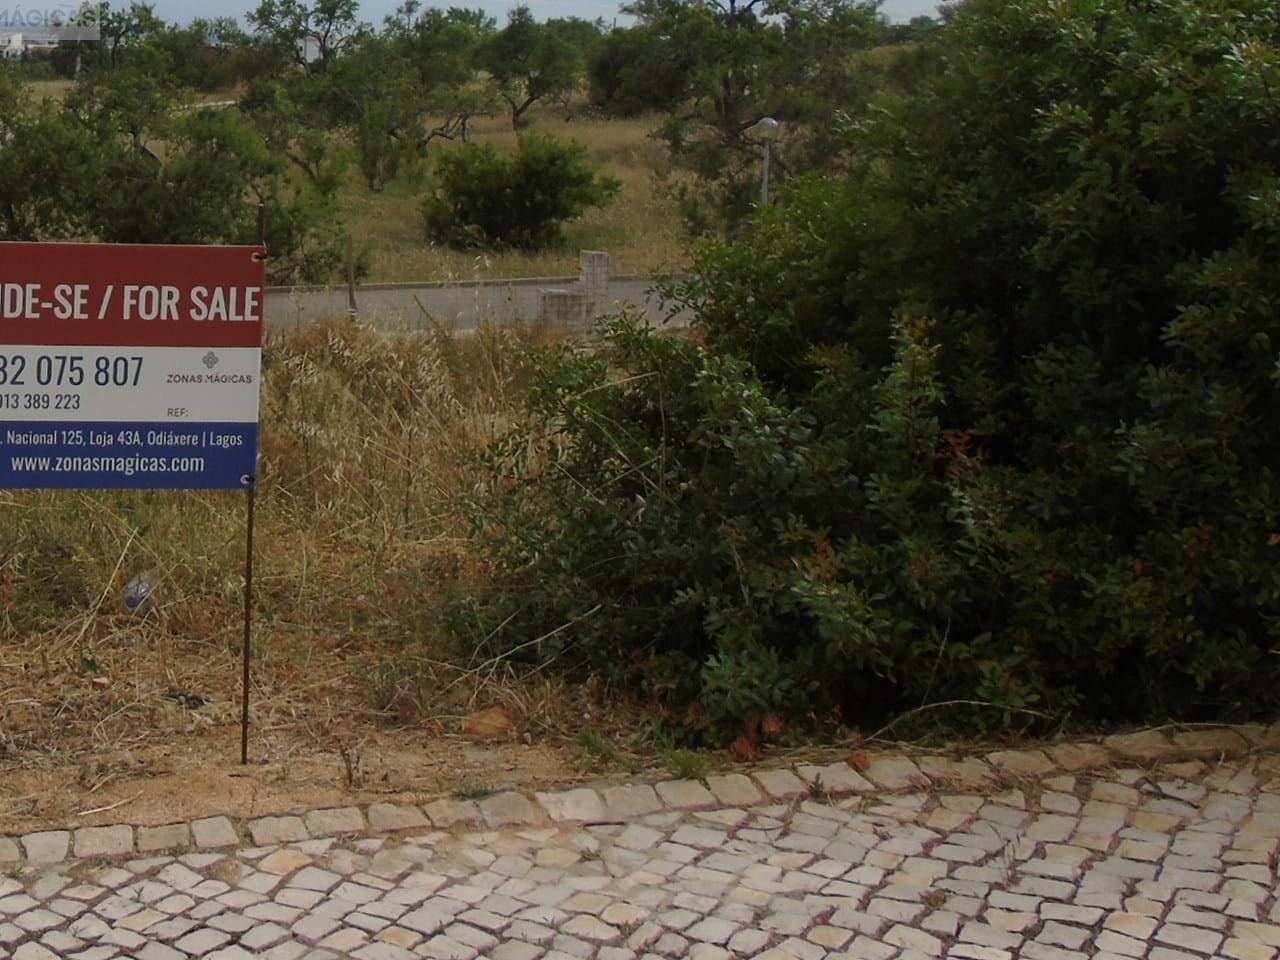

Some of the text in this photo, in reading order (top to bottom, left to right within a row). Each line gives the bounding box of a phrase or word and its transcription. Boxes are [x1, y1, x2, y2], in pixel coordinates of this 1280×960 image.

[97, 284, 114, 320] /
[122, 284, 180, 321] FOR
[189, 285, 261, 321] SALE
[36, 355, 84, 387] 075
[94, 356, 143, 387] 807
[166, 374, 202, 384] ZONAS
[23, 393, 50, 410] 389
[54, 393, 81, 410] 223
[167, 407, 189, 417] REF:
[6, 429, 57, 445] Nacional
[61, 430, 86, 447] 125,
[89, 431, 114, 448] Loja
[117, 430, 144, 448] 43A,
[147, 430, 199, 446] Odiáxere
[209, 431, 243, 449] Lagos
[11, 453, 205, 476] www.zonasmagicas.com
